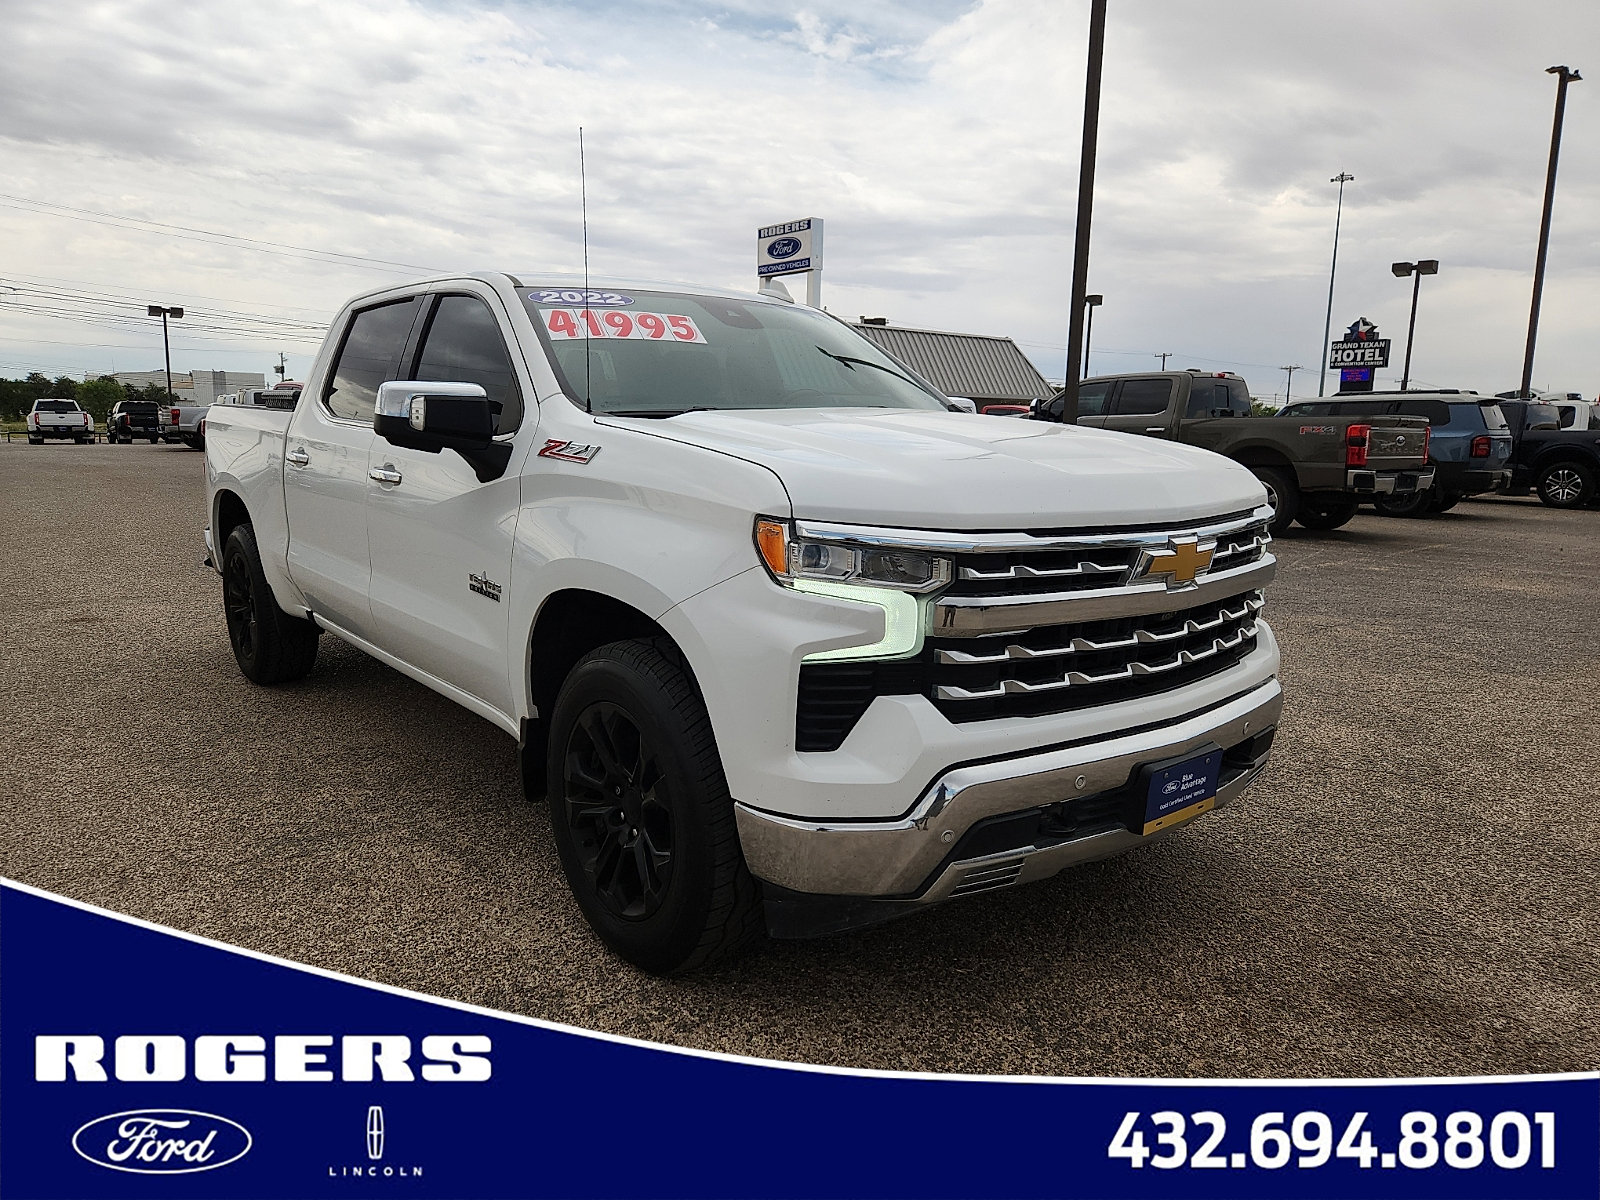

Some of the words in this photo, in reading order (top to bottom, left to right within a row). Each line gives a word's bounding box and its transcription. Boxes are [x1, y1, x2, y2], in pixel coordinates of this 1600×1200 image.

[761, 220, 809, 238] ROGERS
[773, 240, 794, 255] Ford
[786, 259, 809, 269] VEHICLES
[540, 291, 625, 305] 2022
[548, 309, 699, 341] 41995
[1332, 342, 1359, 350] GRAND
[1359, 341, 1386, 349] TEXAN
[1330, 348, 1384, 362] HOTEL
[537, 438, 602, 465] Z71
[1180, 776, 1207, 791] Advantage
[1181, 773, 1194, 783] Blue
[1169, 796, 1184, 807] Certified
